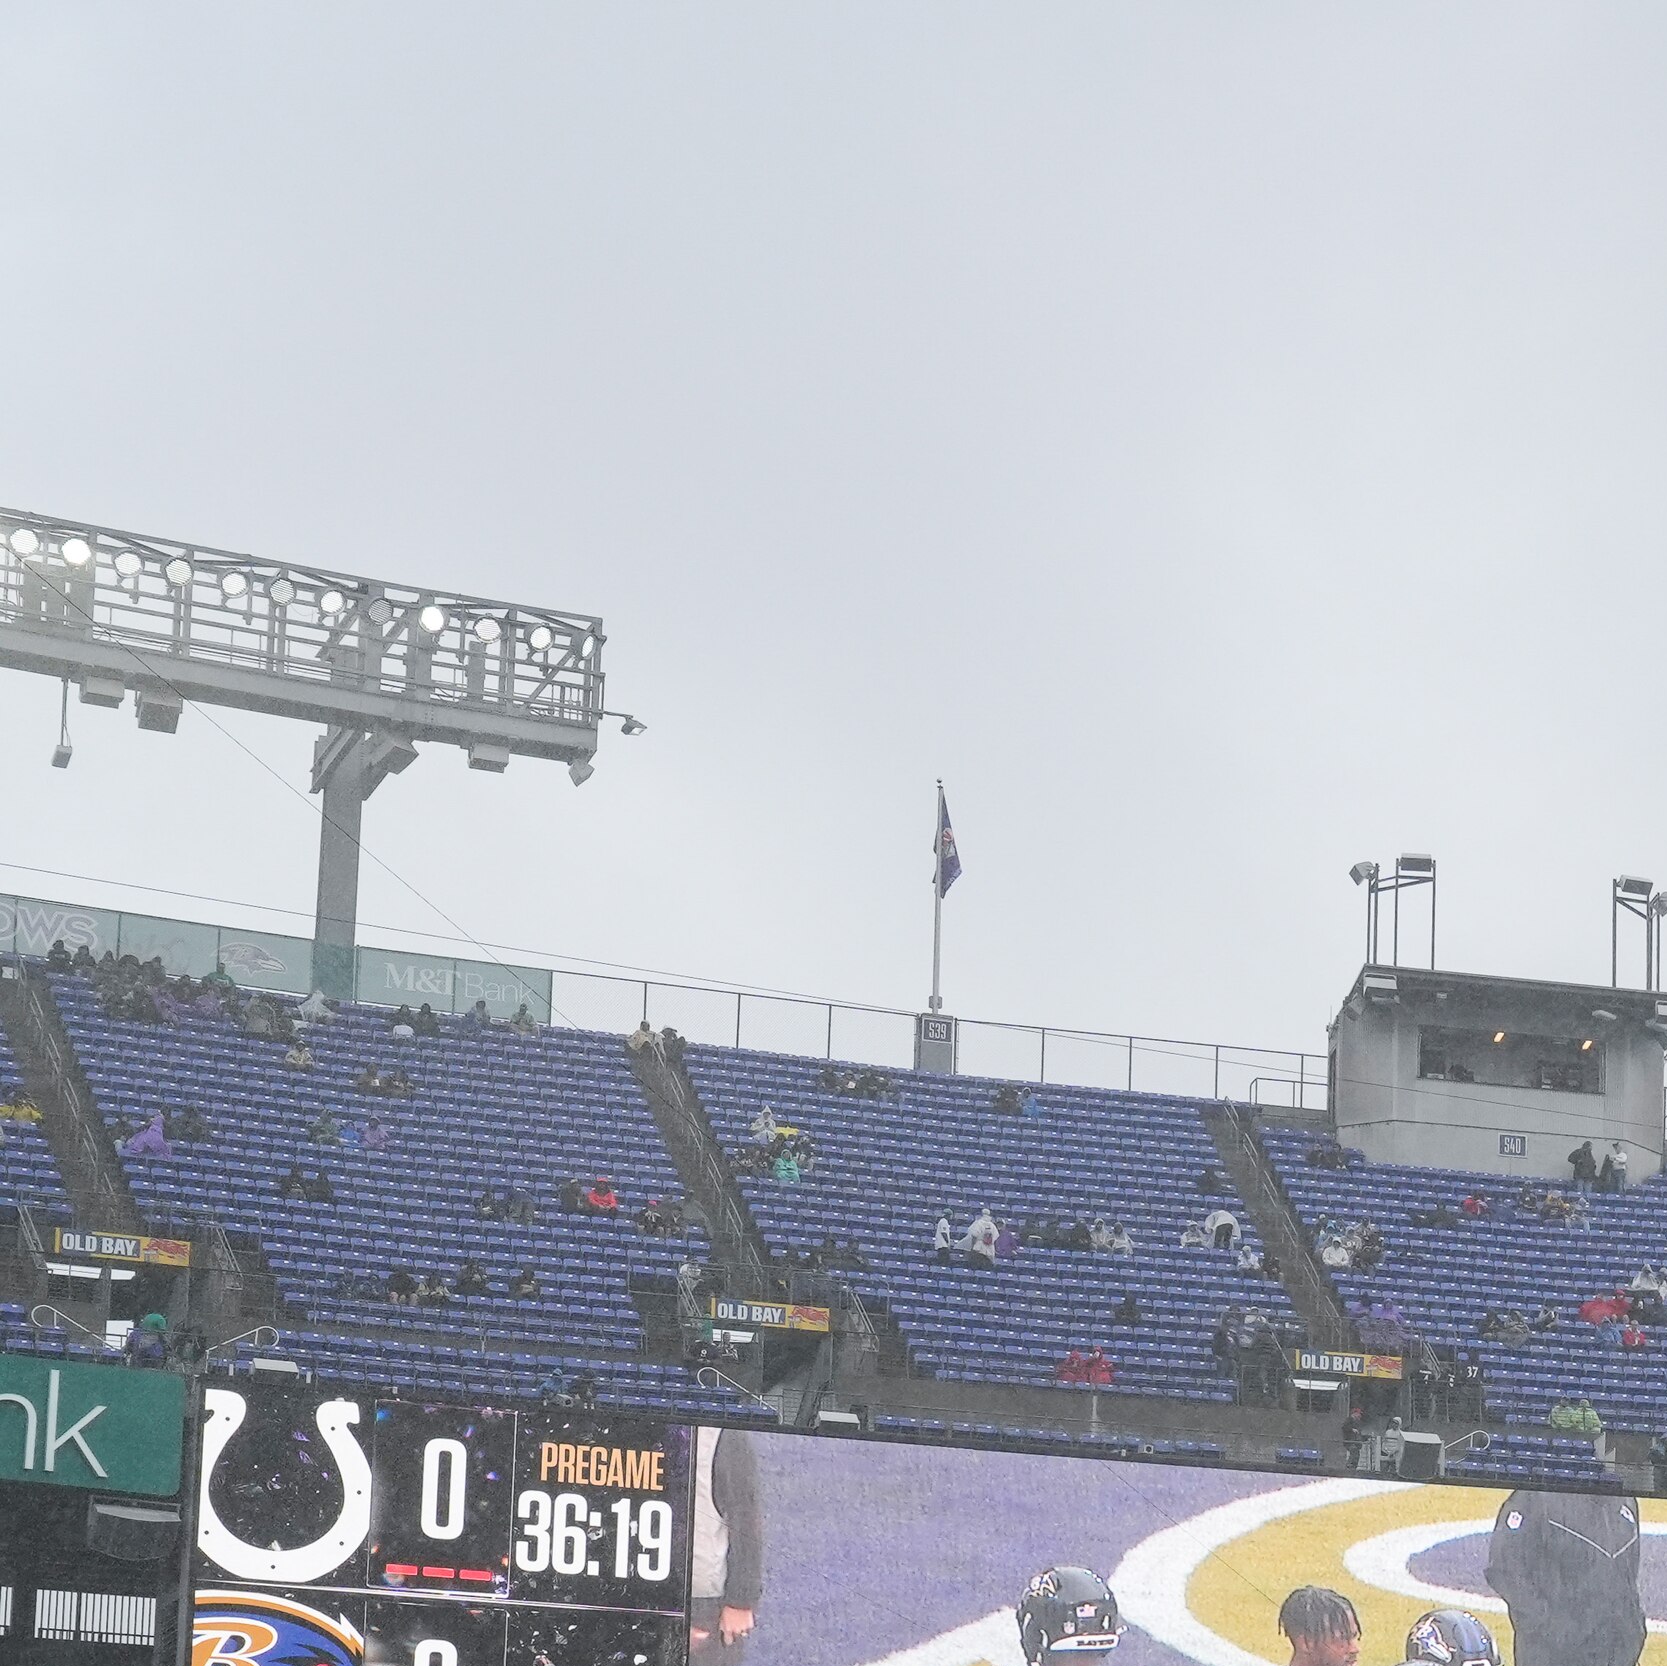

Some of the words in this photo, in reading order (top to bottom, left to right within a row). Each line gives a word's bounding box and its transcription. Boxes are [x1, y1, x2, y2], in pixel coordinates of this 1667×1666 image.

[384, 962, 461, 995] M&T
[465, 973, 535, 1005] Bank
[61, 1234, 96, 1254] OLD
[101, 1236, 136, 1258] BAY
[717, 1301, 746, 1322] OLD
[750, 1303, 781, 1324] BAY
[1302, 1353, 1330, 1371] OLD
[1333, 1355, 1362, 1374] BAY
[540, 1442, 664, 1490] PREGAME
[420, 1437, 466, 1540] 0
[516, 1490, 672, 1582] 36:19
